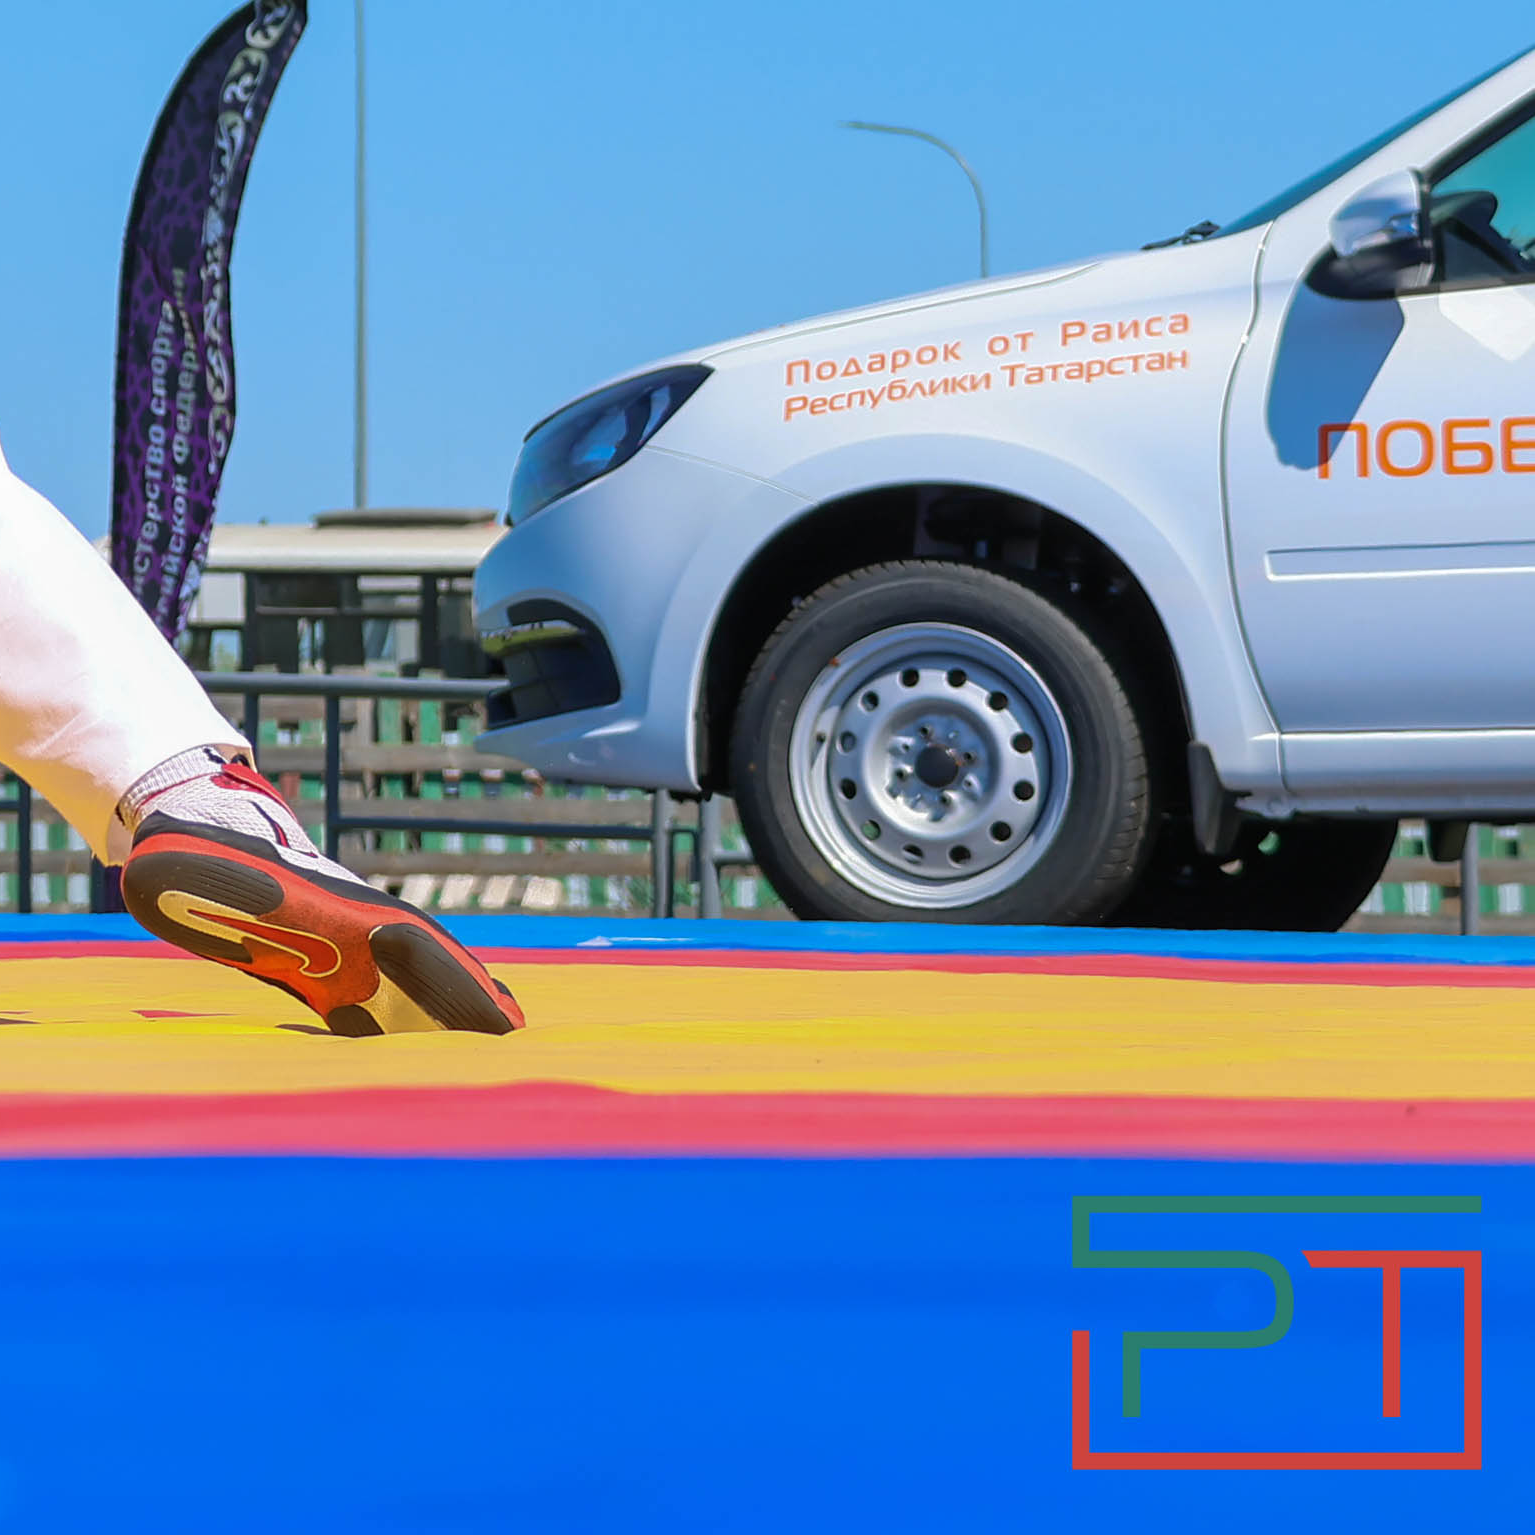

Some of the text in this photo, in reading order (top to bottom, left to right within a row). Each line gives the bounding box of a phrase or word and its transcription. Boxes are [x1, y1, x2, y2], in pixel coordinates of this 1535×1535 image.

[783, 349, 1190, 422] Республики Татарстан
[784, 312, 1190, 386] Подарок от Раиса
